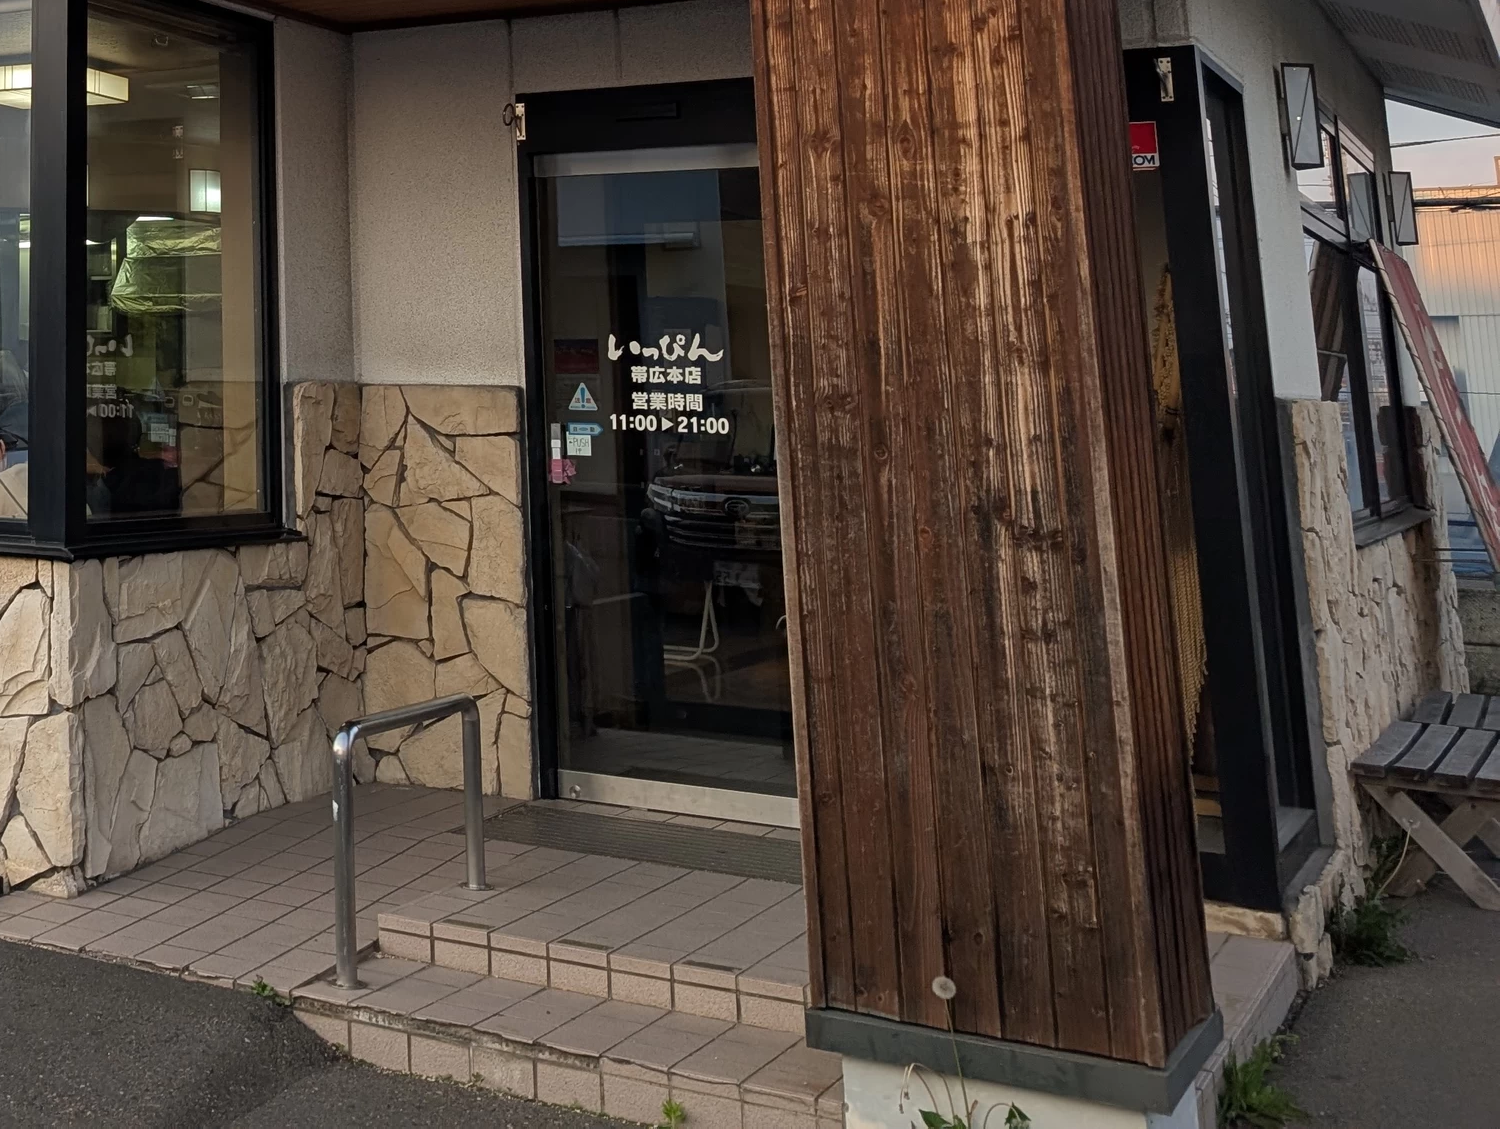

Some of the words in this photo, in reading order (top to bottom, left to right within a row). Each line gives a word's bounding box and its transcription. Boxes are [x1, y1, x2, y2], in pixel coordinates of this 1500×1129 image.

[608, 333, 725, 362] いっぴん
[631, 366, 702, 384] 帯広本店
[631, 392, 703, 411] 営業時間
[610, 414, 657, 431] 11:00
[677, 416, 729, 434] 21:00
[573, 437, 589, 447] PUSH
